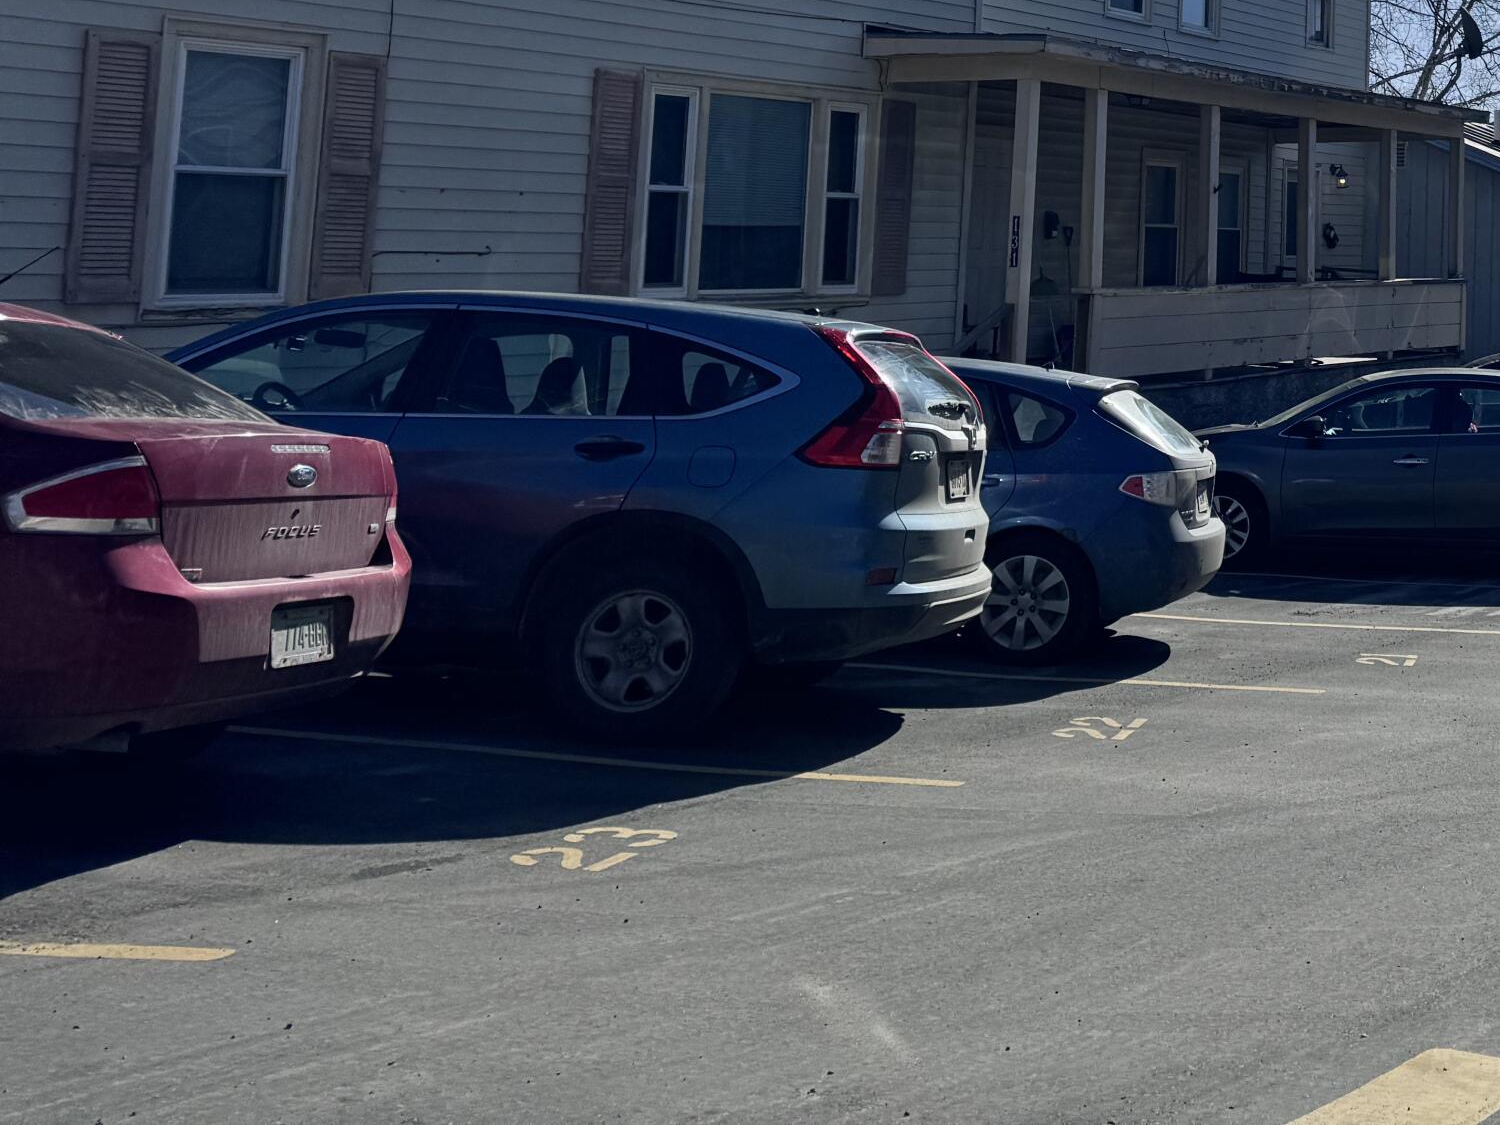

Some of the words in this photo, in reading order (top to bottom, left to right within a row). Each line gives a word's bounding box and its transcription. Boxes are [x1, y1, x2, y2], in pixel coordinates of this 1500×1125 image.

[1010, 217, 1019, 267] 131
[261, 525, 322, 541] FOCUS
[1355, 653, 1418, 667] 21
[1051, 716, 1149, 740] 22
[510, 826, 678, 872] 23
